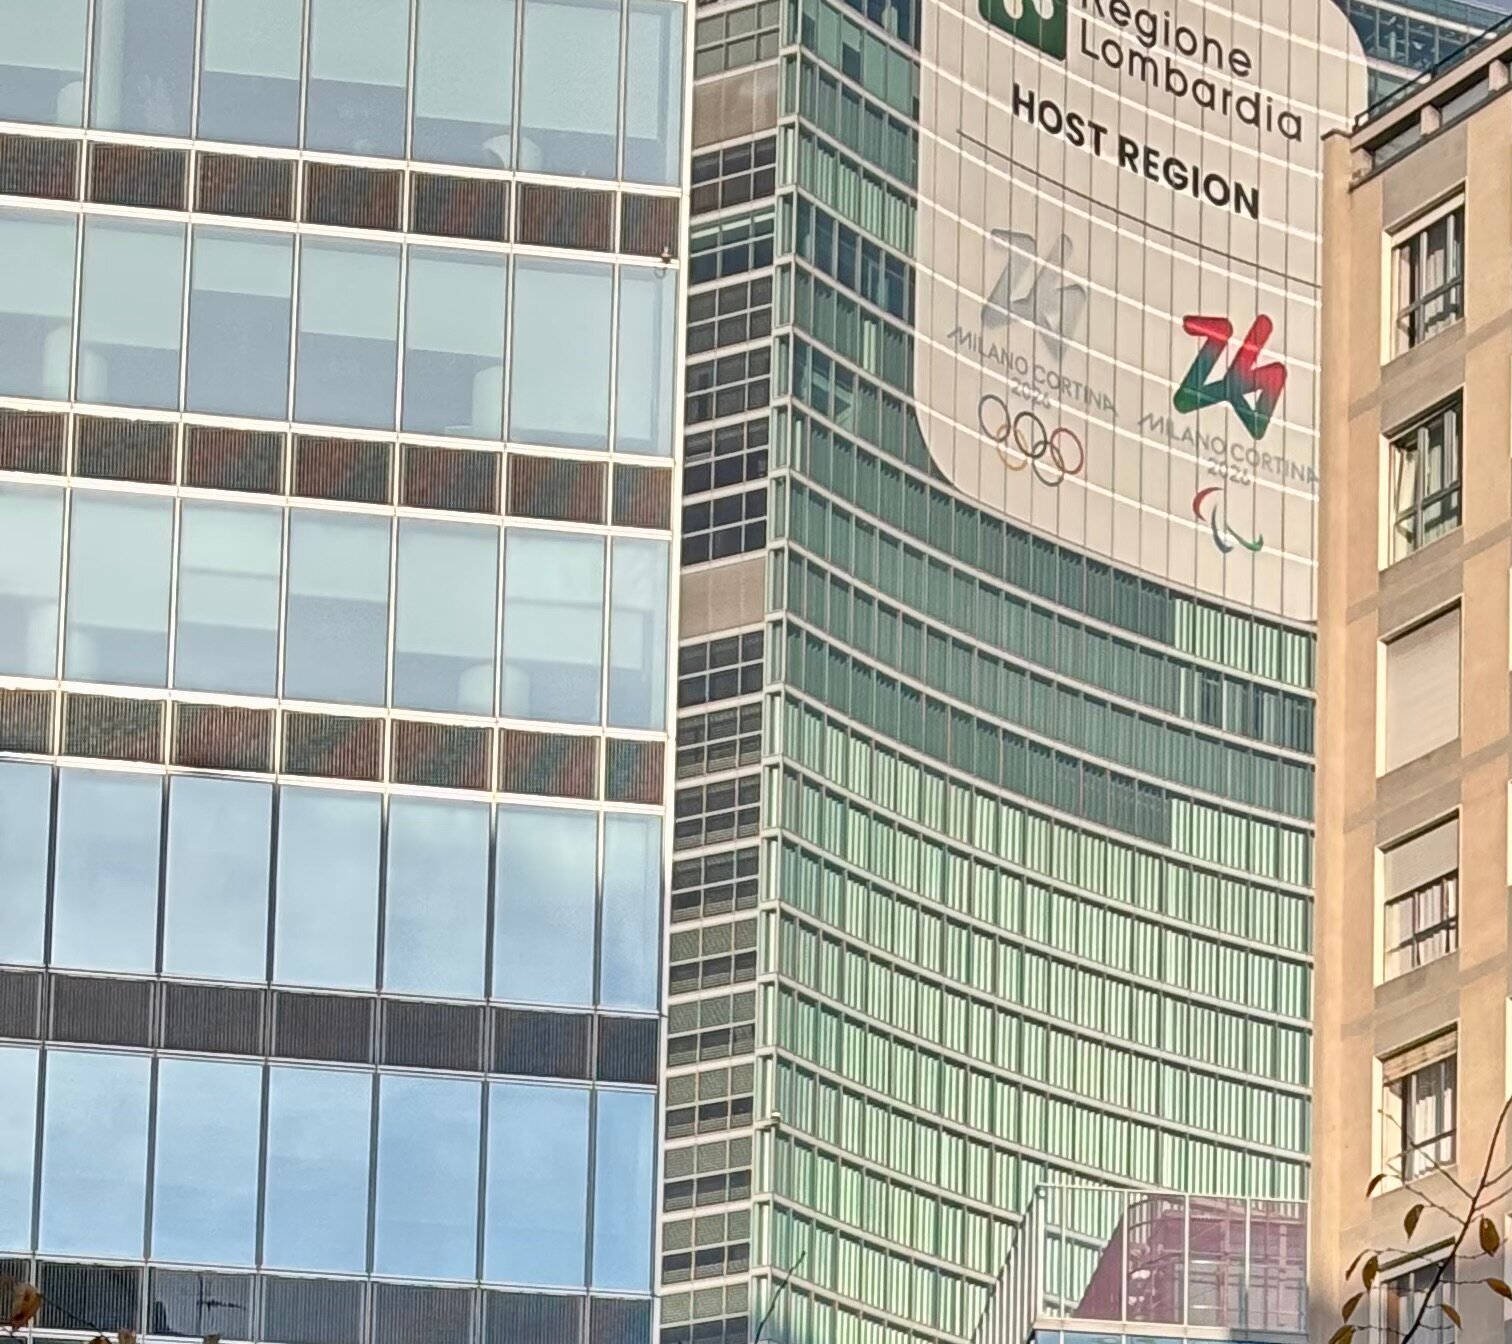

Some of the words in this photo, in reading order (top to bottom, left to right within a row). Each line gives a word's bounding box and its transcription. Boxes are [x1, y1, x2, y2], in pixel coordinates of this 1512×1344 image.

[1081, 17, 1302, 142] Lombardia
[1012, 82, 1108, 157] HOST
[1118, 134, 1259, 220] REGION
[947, 326, 1028, 375] MILANO
[1032, 364, 1118, 418] CORTINA
[1137, 412, 1224, 455] MILANO
[1230, 443, 1319, 484] CORTINA
